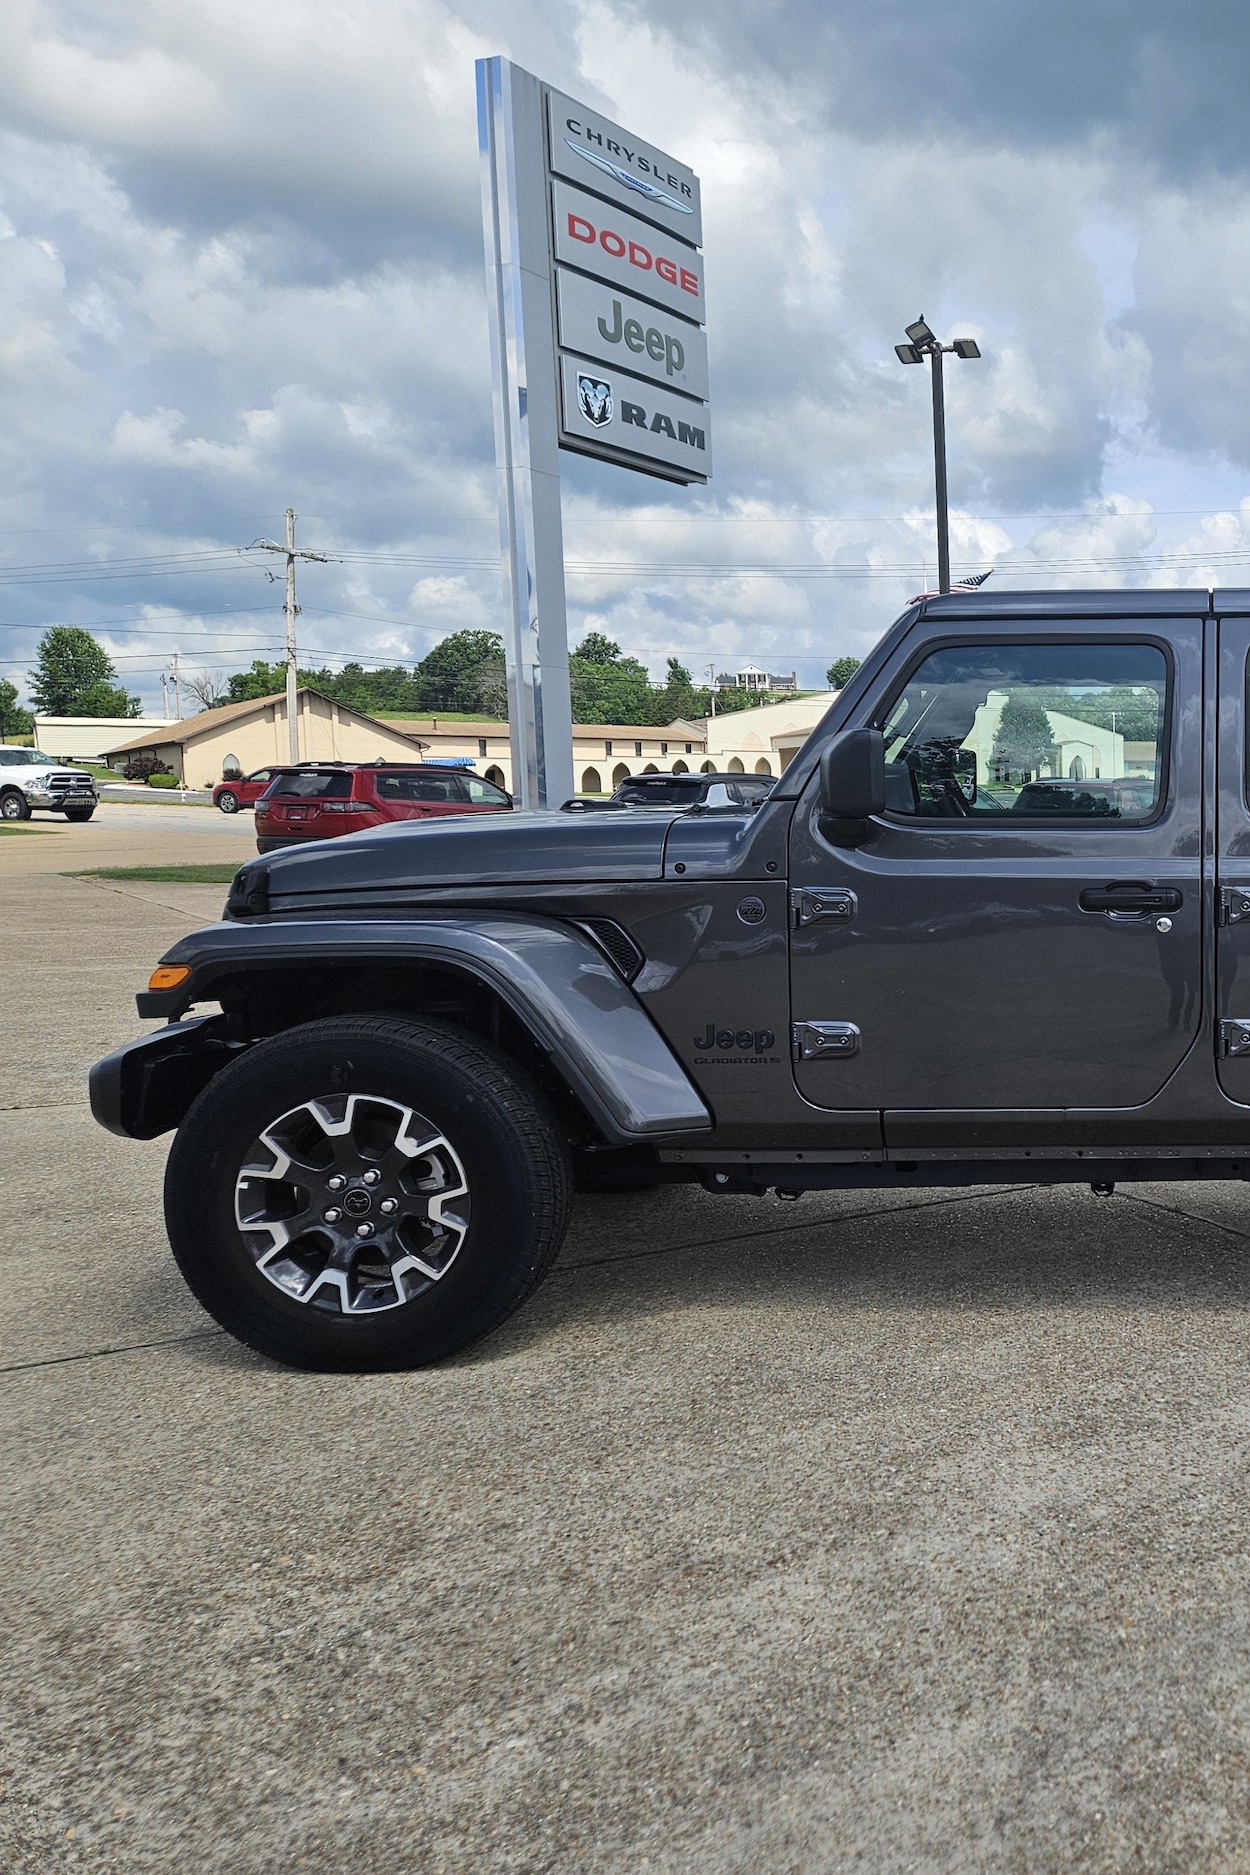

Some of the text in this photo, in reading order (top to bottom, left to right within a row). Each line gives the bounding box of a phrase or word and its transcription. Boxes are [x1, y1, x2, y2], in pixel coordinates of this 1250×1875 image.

[566, 118, 692, 199] CHRYSLER
[567, 212, 699, 297] DODGE
[597, 299, 685, 376] Jeep
[620, 399, 705, 451] RAM
[693, 1023, 775, 1054] Jeep
[693, 1057, 769, 1065] GLADIATOR
